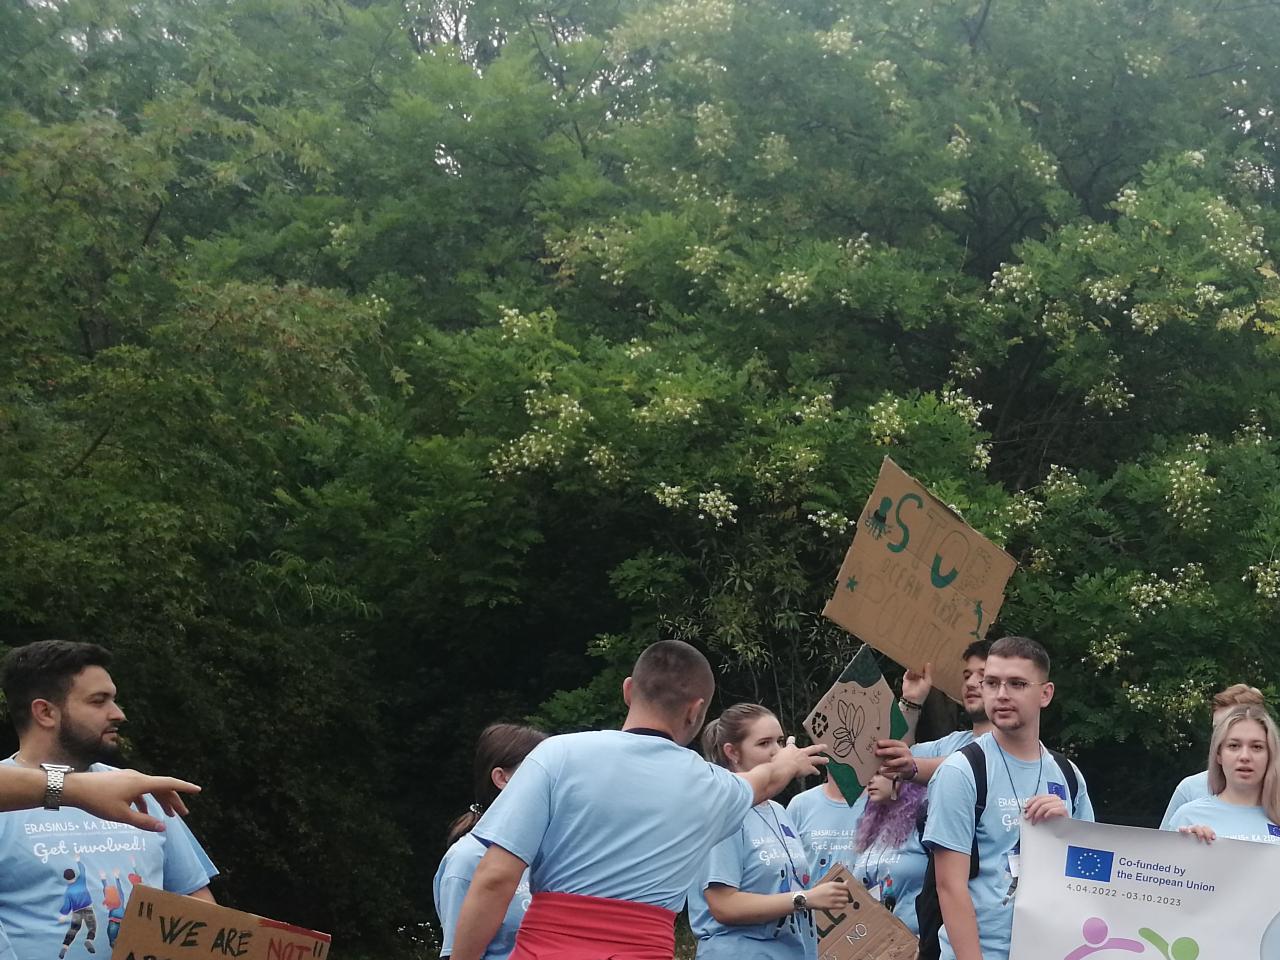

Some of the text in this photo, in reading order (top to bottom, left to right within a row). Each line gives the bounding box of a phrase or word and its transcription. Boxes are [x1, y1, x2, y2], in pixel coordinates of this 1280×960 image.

[83, 821, 98, 831] KA
[34, 836, 146, 864] Get involved!
[1118, 857, 1186, 877] Co-funded by
[1117, 870, 1215, 892] the European Union
[210, 927, 253, 958] ARE
[846, 923, 868, 945] NO
